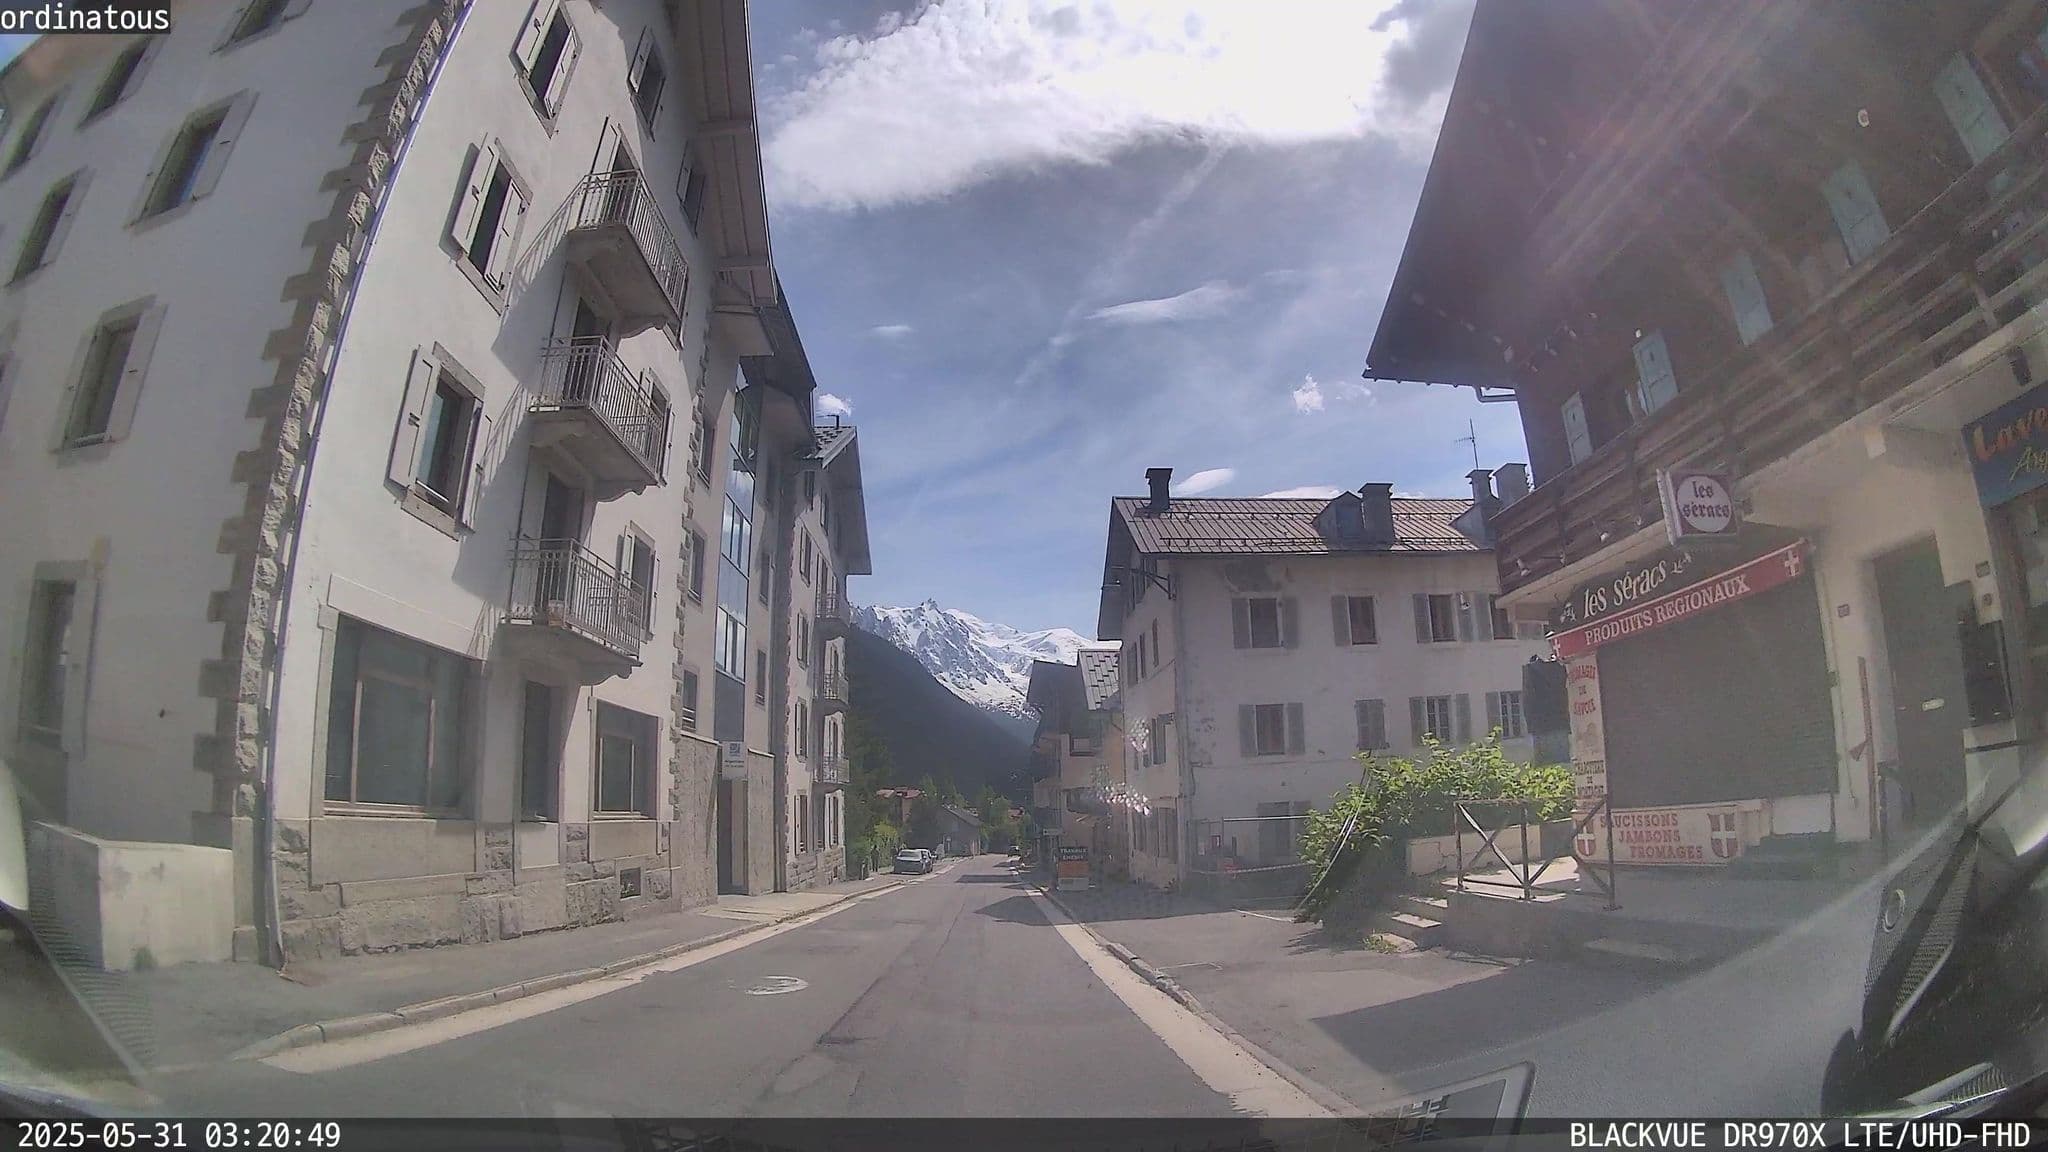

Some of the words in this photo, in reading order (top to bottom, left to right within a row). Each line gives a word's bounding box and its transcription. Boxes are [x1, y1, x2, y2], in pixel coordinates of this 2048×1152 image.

[1692, 480, 1713, 498] les
[1583, 585, 1607, 619] les
[1613, 560, 1667, 606] séracs
[1585, 611, 1653, 645] PRODUITS
[1656, 573, 1750, 624] REGIONAUX
[1619, 830, 1680, 843] JAMBONS
[1629, 846, 1704, 859] FROMAGES
